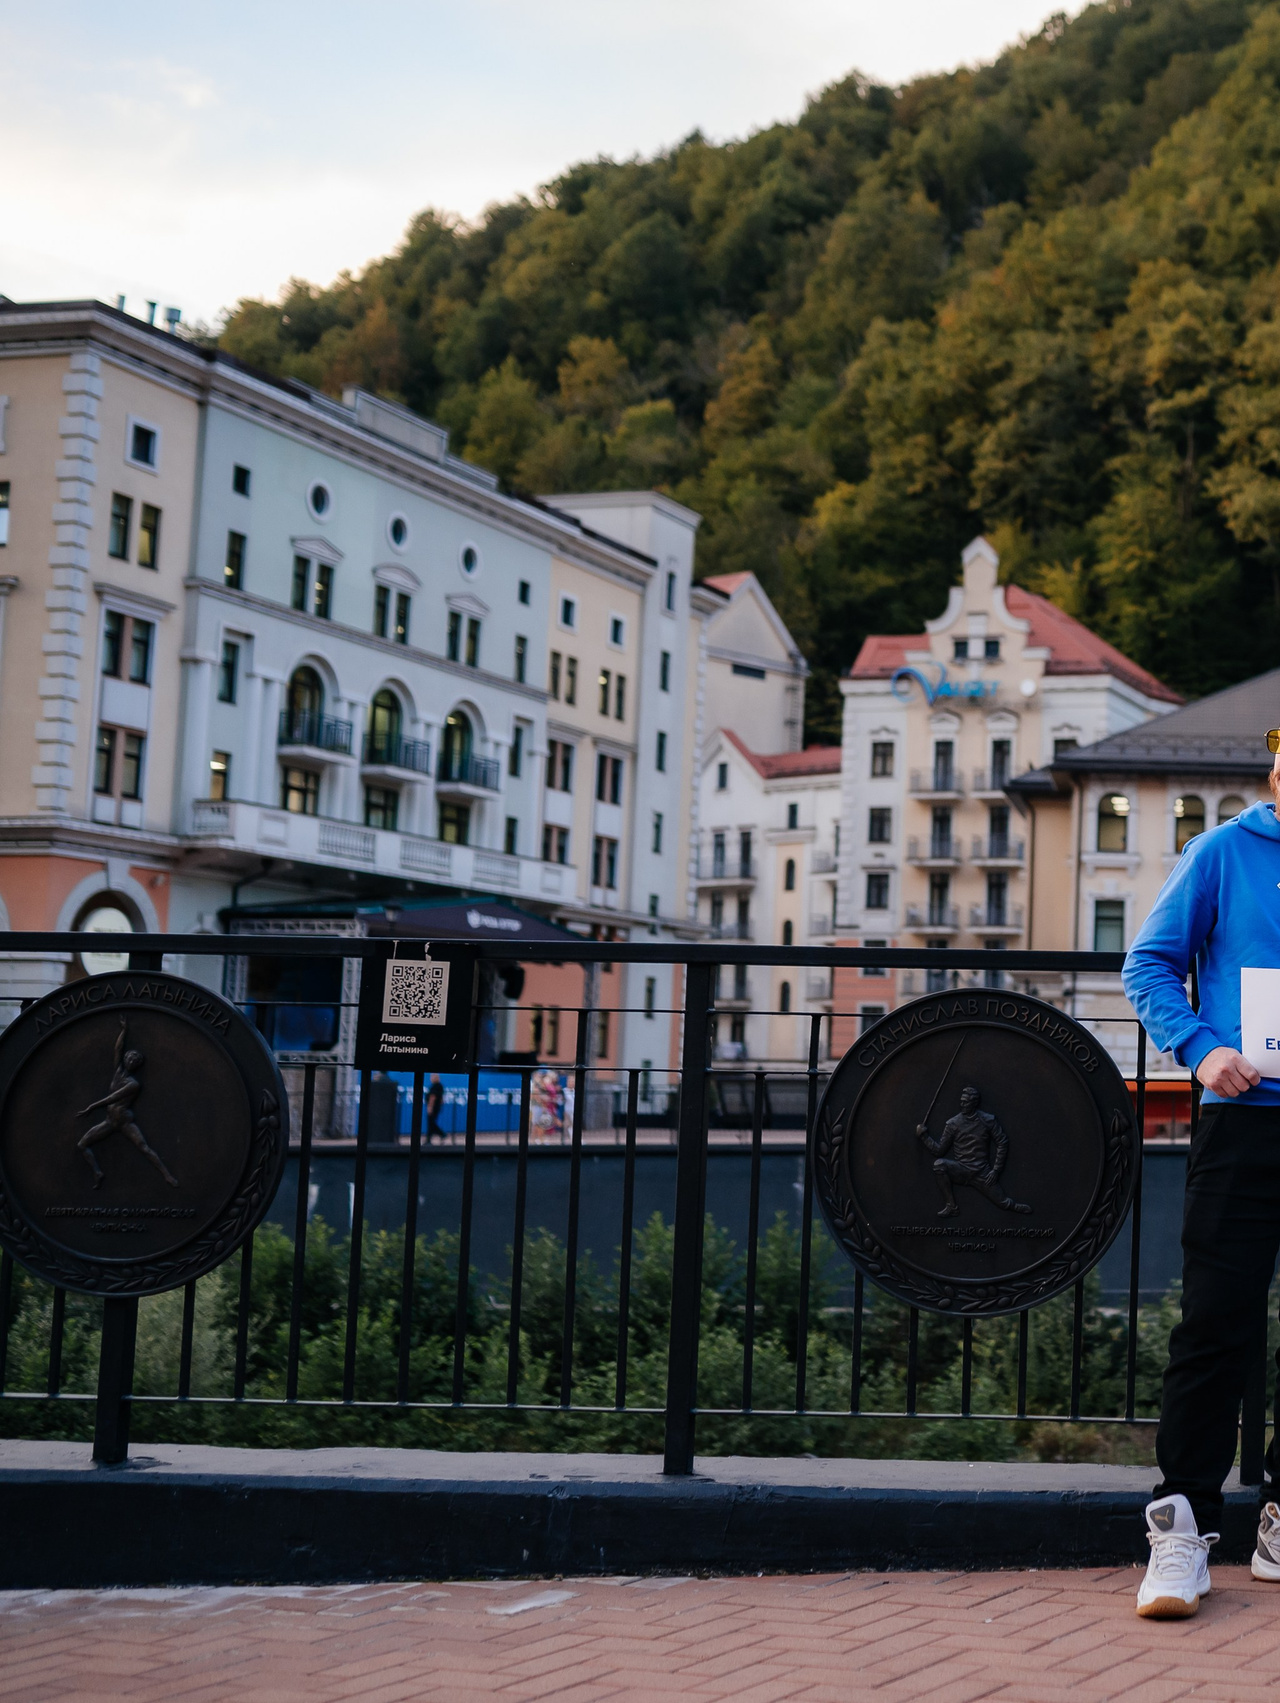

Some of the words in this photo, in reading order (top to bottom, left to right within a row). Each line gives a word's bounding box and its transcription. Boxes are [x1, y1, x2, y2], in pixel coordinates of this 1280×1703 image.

[33, 982, 118, 1034] ЛАРИСА
[121, 981, 232, 1036] ЛАТЫНИНА
[379, 1033, 417, 1043] Лариса
[857, 998, 980, 1068] СТАНИСЛАВ
[985, 998, 1101, 1073] ПОЗДНЯКОВ
[379, 1044, 429, 1054] Латынина
[978, 1226, 1056, 1238] ОЛИМПИЙСКИЙ
[947, 1242, 997, 1253] ЧЕМПИОН
